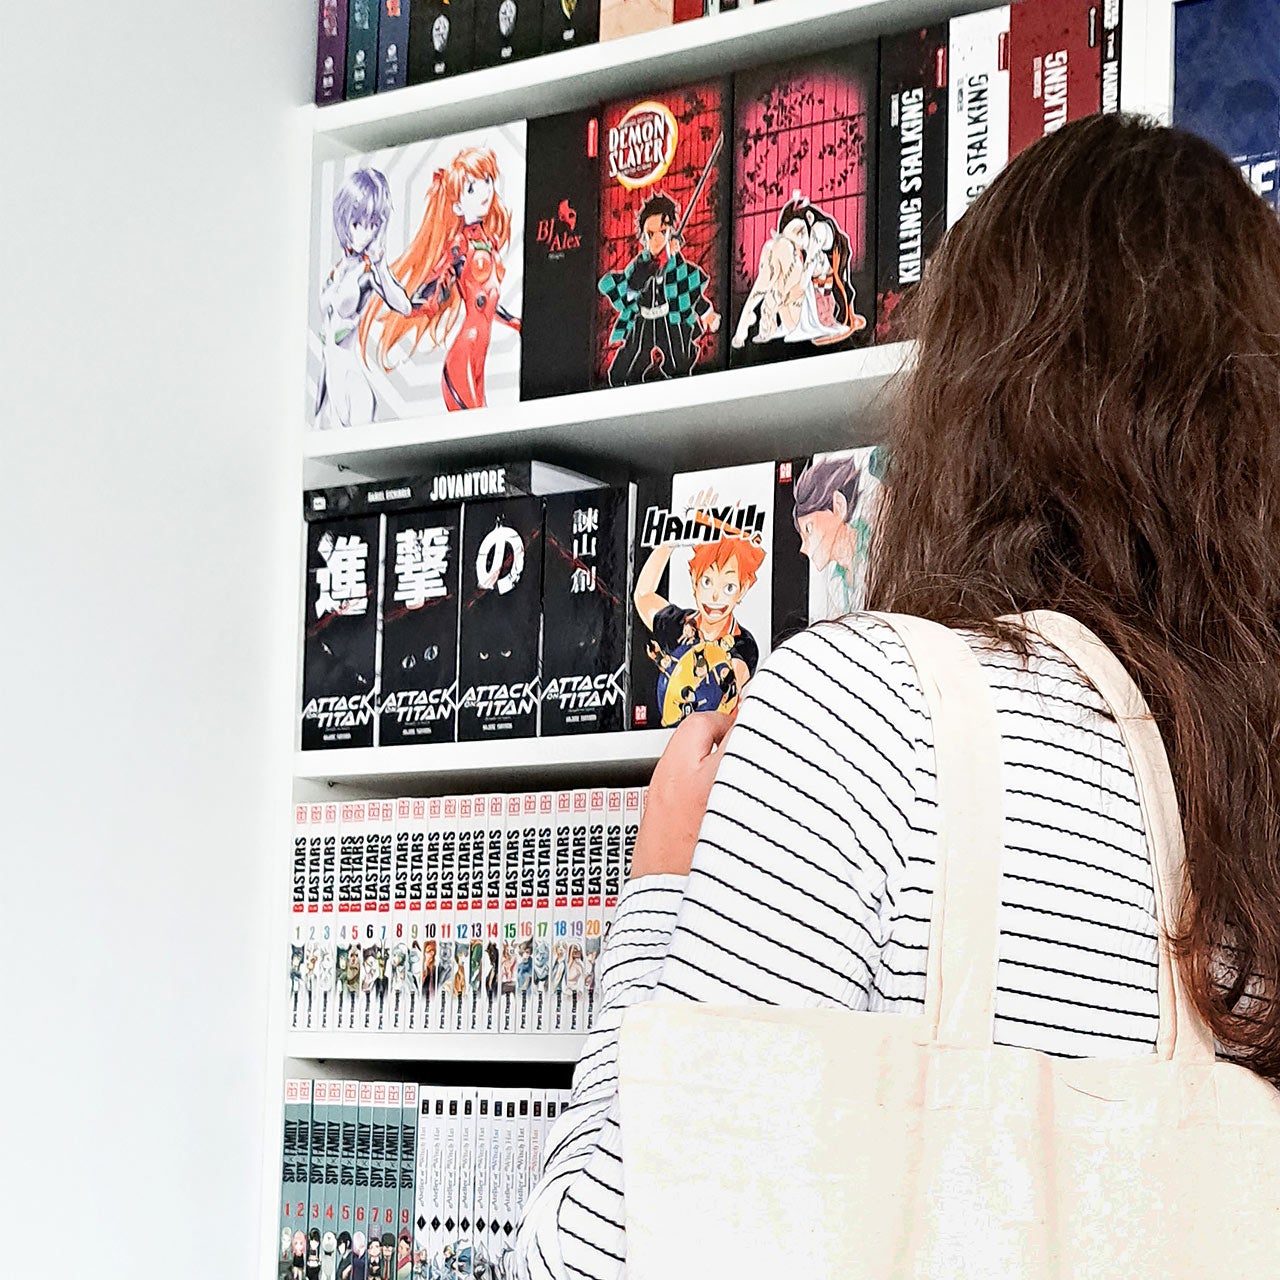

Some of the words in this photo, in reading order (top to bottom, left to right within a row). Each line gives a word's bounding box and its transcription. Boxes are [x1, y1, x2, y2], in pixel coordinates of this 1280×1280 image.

[1044, 50, 1067, 136] ALKING
[609, 114, 664, 152] DEMON
[901, 88, 924, 193] STALKING
[967, 73, 989, 177] STALKING
[609, 138, 666, 177] SLAYER
[537, 220, 555, 247] BJ
[552, 233, 582, 252] Alex
[900, 198, 923, 285] KILLING
[430, 468, 506, 501] JOVANTORE
[316, 531, 368, 619] 進
[476, 525, 525, 595] の
[379, 682, 458, 713] ATTACK
[458, 677, 539, 708] ATTACK
[540, 665, 626, 704] ATTACK
[302, 689, 378, 719] ATTACK
[397, 706, 450, 723] TITAN
[476, 701, 532, 718] TITAN
[559, 693, 618, 709] TITAN
[317, 711, 371, 728] TITAN
[293, 837, 306, 912] BEASTARS
[364, 834, 379, 911] BEASTARS
[425, 831, 440, 910] BEASTARS
[471, 829, 485, 909] BEASTARS
[504, 828, 519, 908] BEASTARS
[366, 925, 373, 938] 6
[396, 924, 402, 938] 8
[425, 925, 436, 938] 10
[312, 1122, 326, 1155] FAMILY
[372, 1123, 385, 1158] FAMILY
[311, 1165, 324, 1184] SPY
[370, 1168, 384, 1187] SPY
[296, 1202, 304, 1217] 2
[312, 1205, 319, 1218] 3
[342, 1205, 349, 1219] 5
